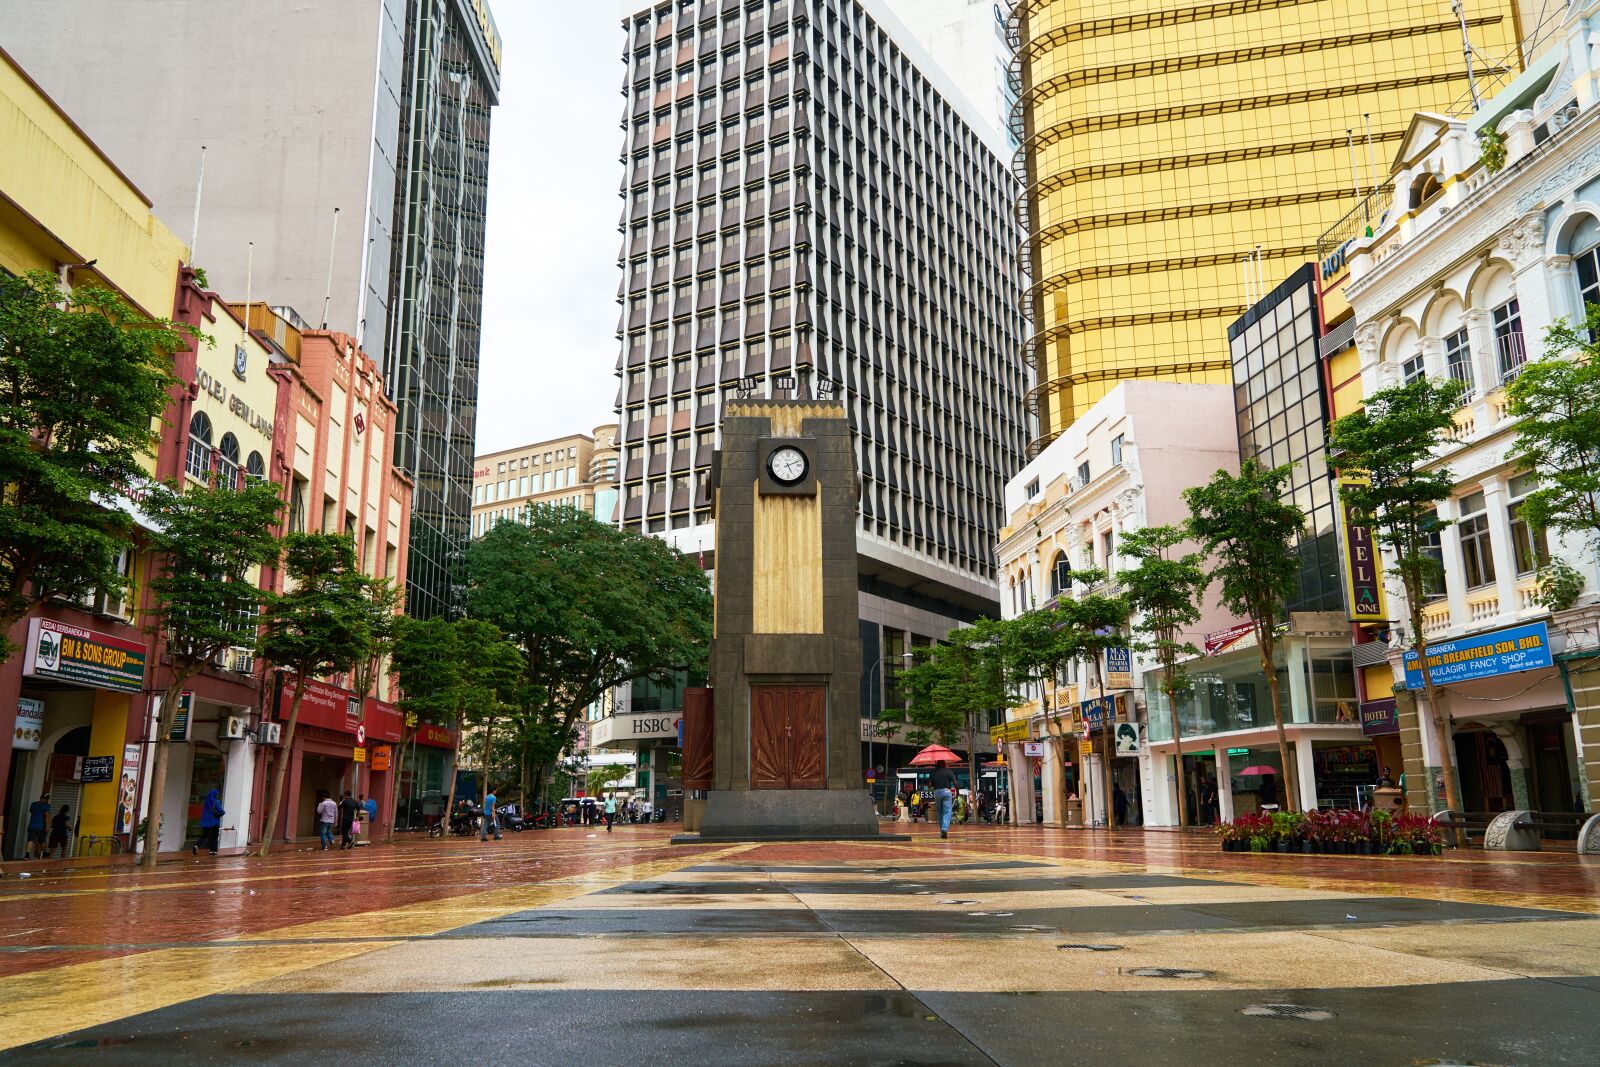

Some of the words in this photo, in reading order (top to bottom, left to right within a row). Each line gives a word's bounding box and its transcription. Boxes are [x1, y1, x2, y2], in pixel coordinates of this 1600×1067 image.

[196, 367, 226, 404] KOLEJ
[1348, 487, 1371, 582] OTEL
[1357, 603, 1379, 613] ONE
[41, 620, 56, 629] KEDAI
[61, 638, 74, 657] BM
[75, 643, 82, 659] &
[82, 643, 103, 664] SONS
[103, 648, 127, 668] GROUP
[1425, 643, 1457, 656] ERBANEKA
[1443, 645, 1494, 665] BREAKFIELD
[1495, 640, 1518, 655] SDN.
[1518, 635, 1543, 650] BHD.
[1469, 657, 1497, 670] FANCY
[1501, 652, 1526, 665] SHOP
[1085, 698, 1111, 715] FARMSI
[1364, 710, 1389, 721] HOTEL
[632, 718, 671, 733] HSBC
